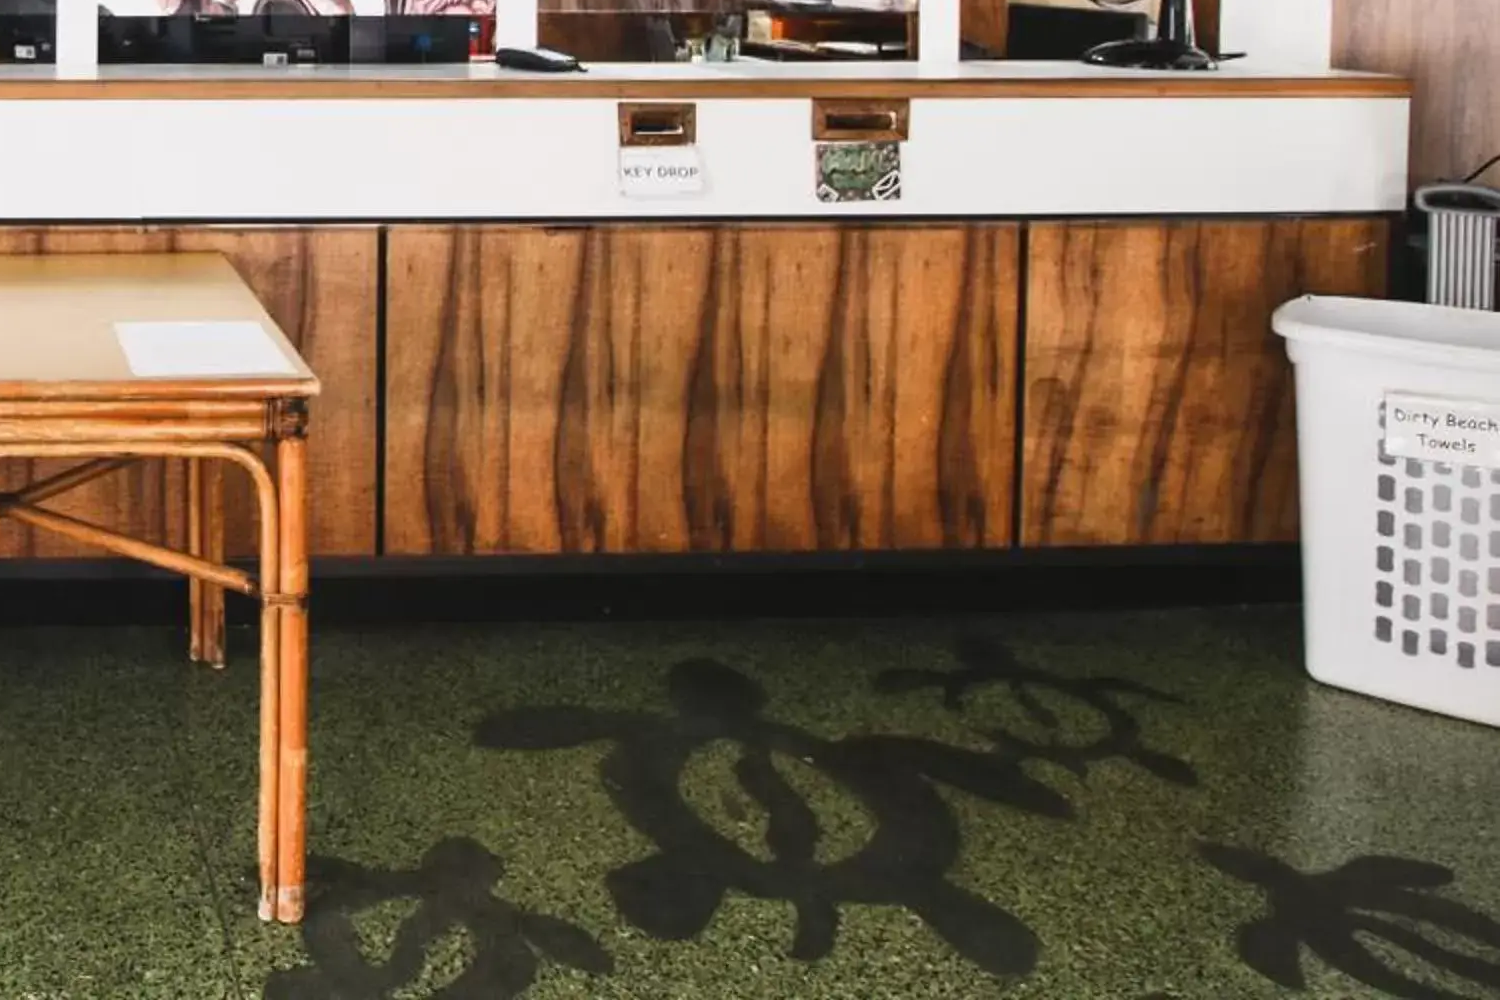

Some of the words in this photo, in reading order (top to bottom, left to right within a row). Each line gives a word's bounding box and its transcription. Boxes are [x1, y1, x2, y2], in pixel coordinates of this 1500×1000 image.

[623, 166, 653, 178] KEY
[657, 166, 700, 179] DROP
[1394, 407, 1439, 428] Dirty
[1446, 413, 1499, 433] Beach
[1416, 433, 1476, 453] Towels
